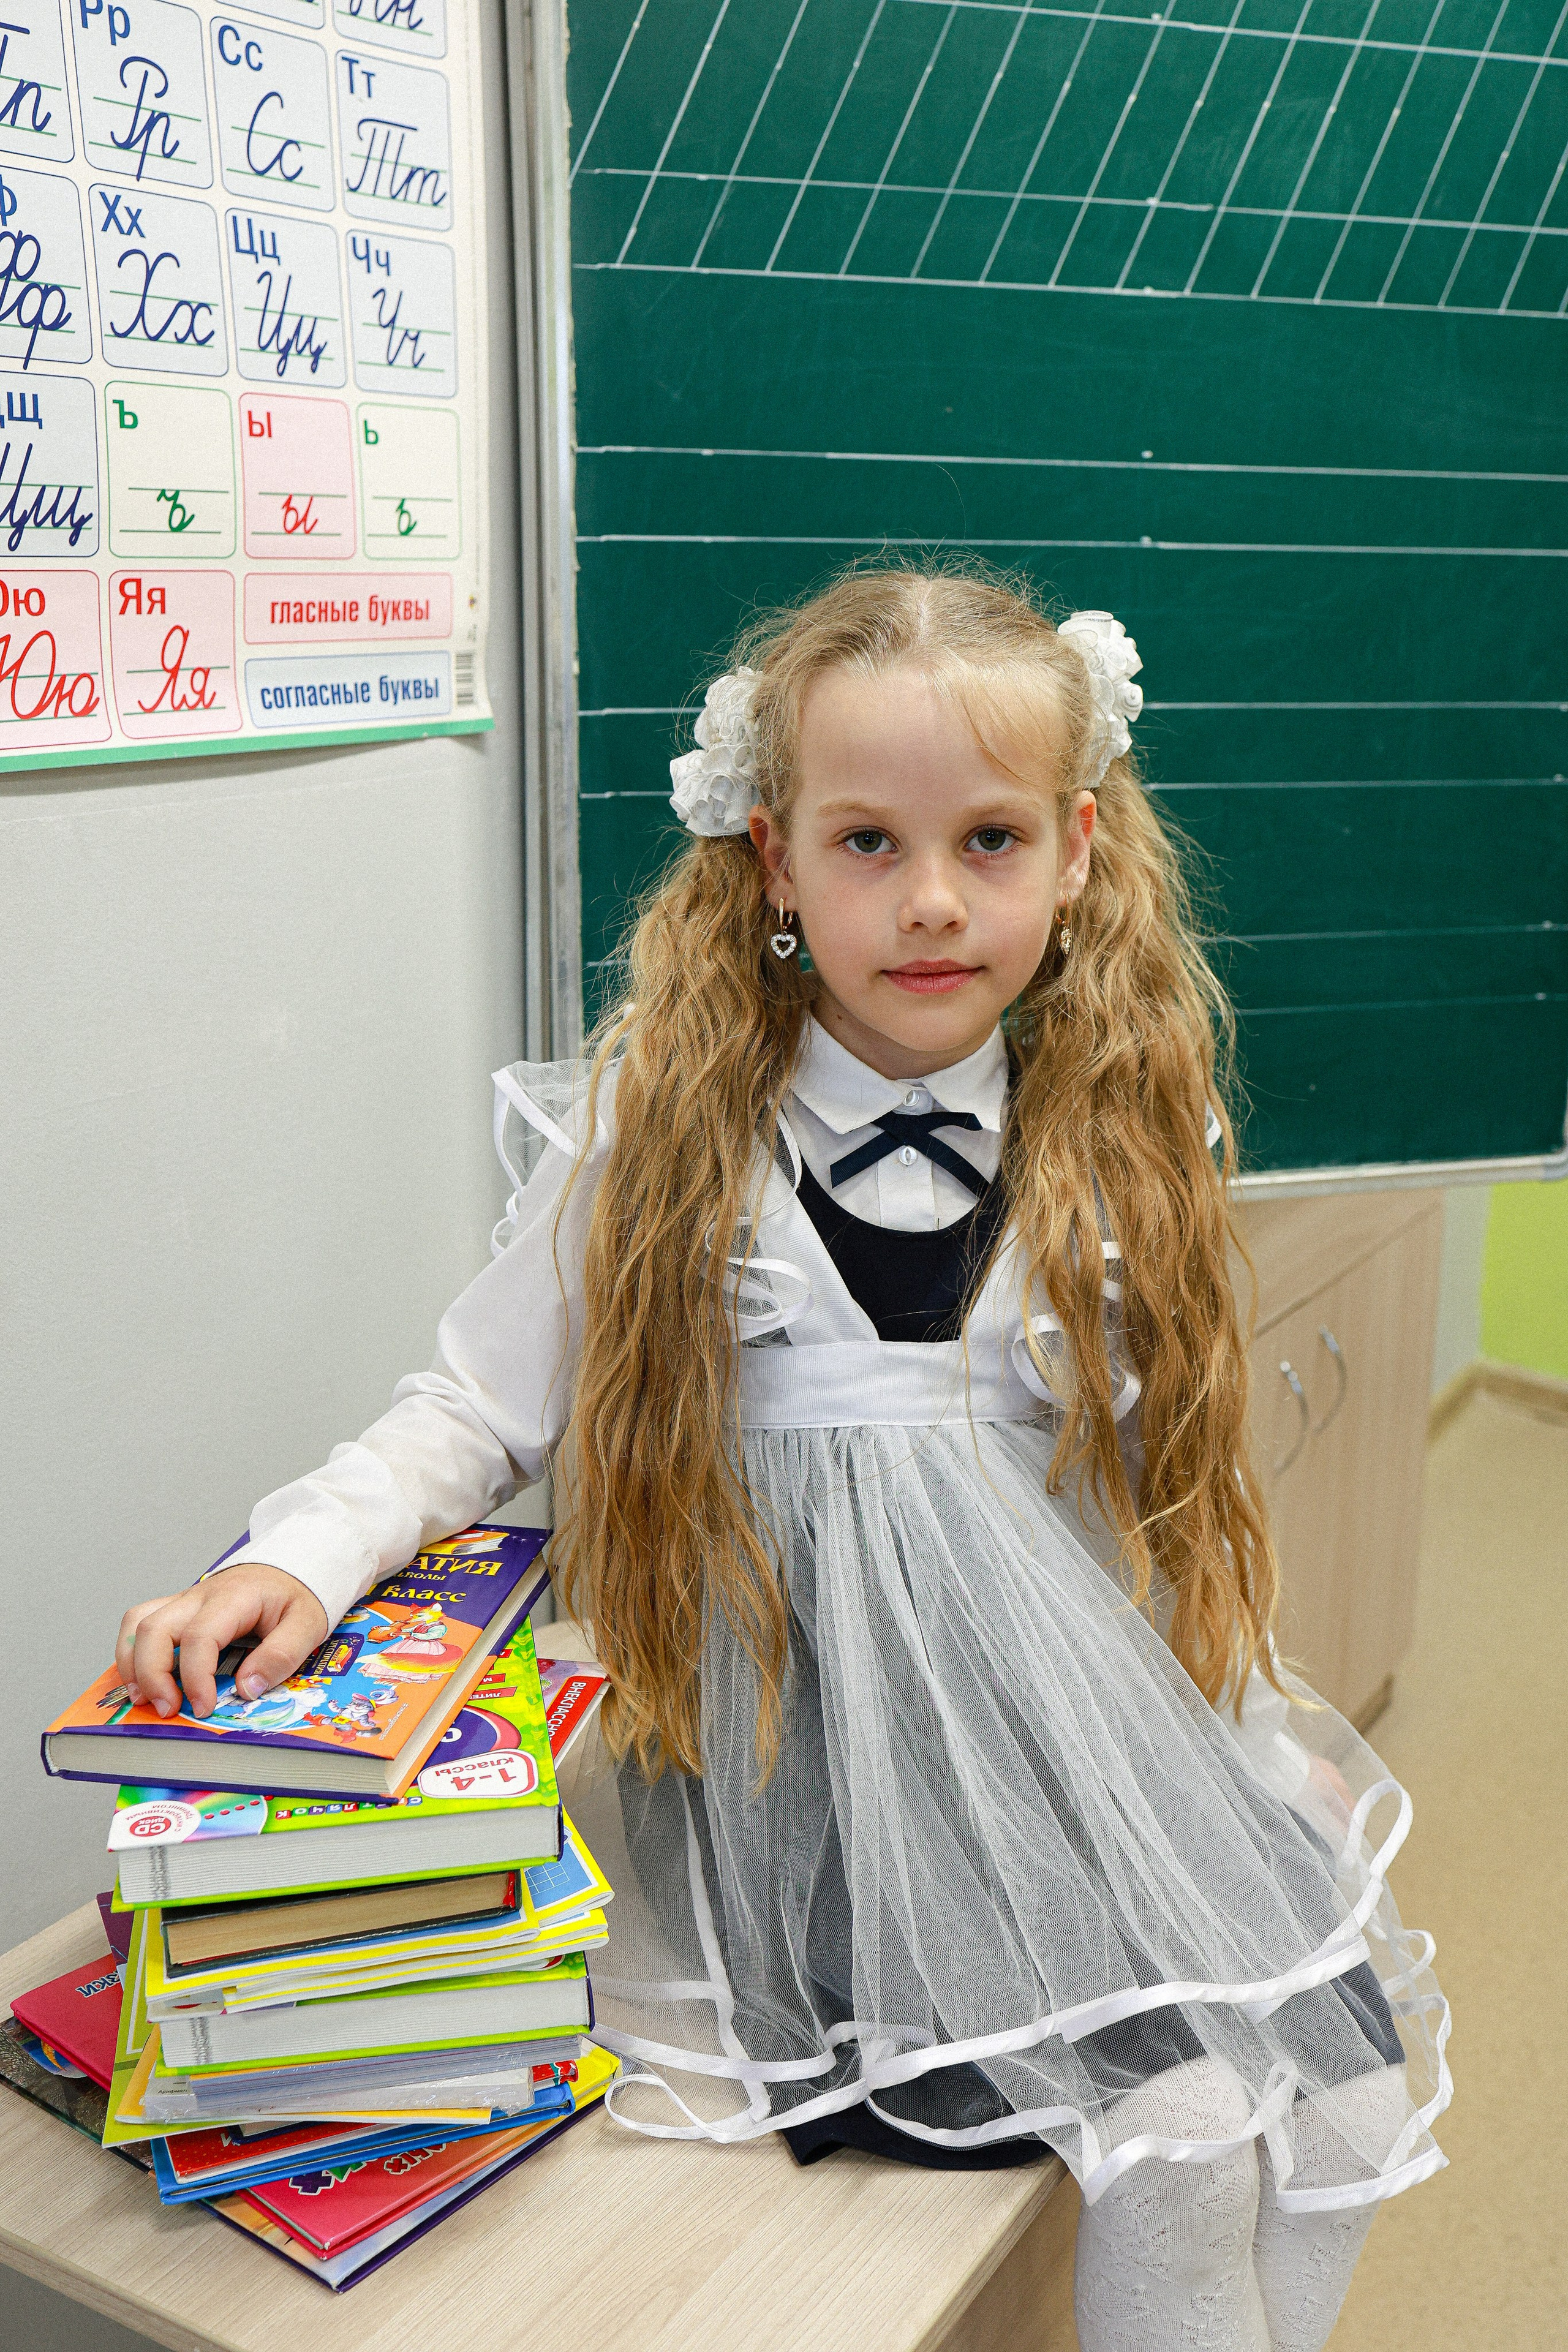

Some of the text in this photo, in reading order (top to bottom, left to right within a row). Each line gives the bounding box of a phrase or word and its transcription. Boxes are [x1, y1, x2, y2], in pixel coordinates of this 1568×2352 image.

[80, 0, 130, 46] Рр
[218, 25, 263, 71] Сс
[342, 56, 375, 97] Тт
[111, 56, 179, 182] Рр
[247, 91, 303, 181] Сс
[347, 118, 447, 206] Тт
[99, 192, 146, 238] Хх
[232, 216, 280, 265] Цц
[352, 236, 390, 276] Чч
[110, 249, 214, 345] Хх
[257, 271, 327, 376] Цц
[372, 288, 425, 368] Чч
[0, 392, 43, 429] щ
[157, 489, 195, 532] ъ
[282, 494, 318, 534] ы
[396, 498, 417, 535] ь
[119, 578, 165, 615] Яя
[270, 594, 429, 625] гласные буквы
[138, 625, 216, 713] Яя
[260, 675, 440, 709] согласные буквы
[381, 1585, 467, 1602] класс
[548, 1681, 587, 1741] ВНЕКЛАССНО
[435, 1757, 514, 1777] классы
[134, 1823, 166, 1835] CD
